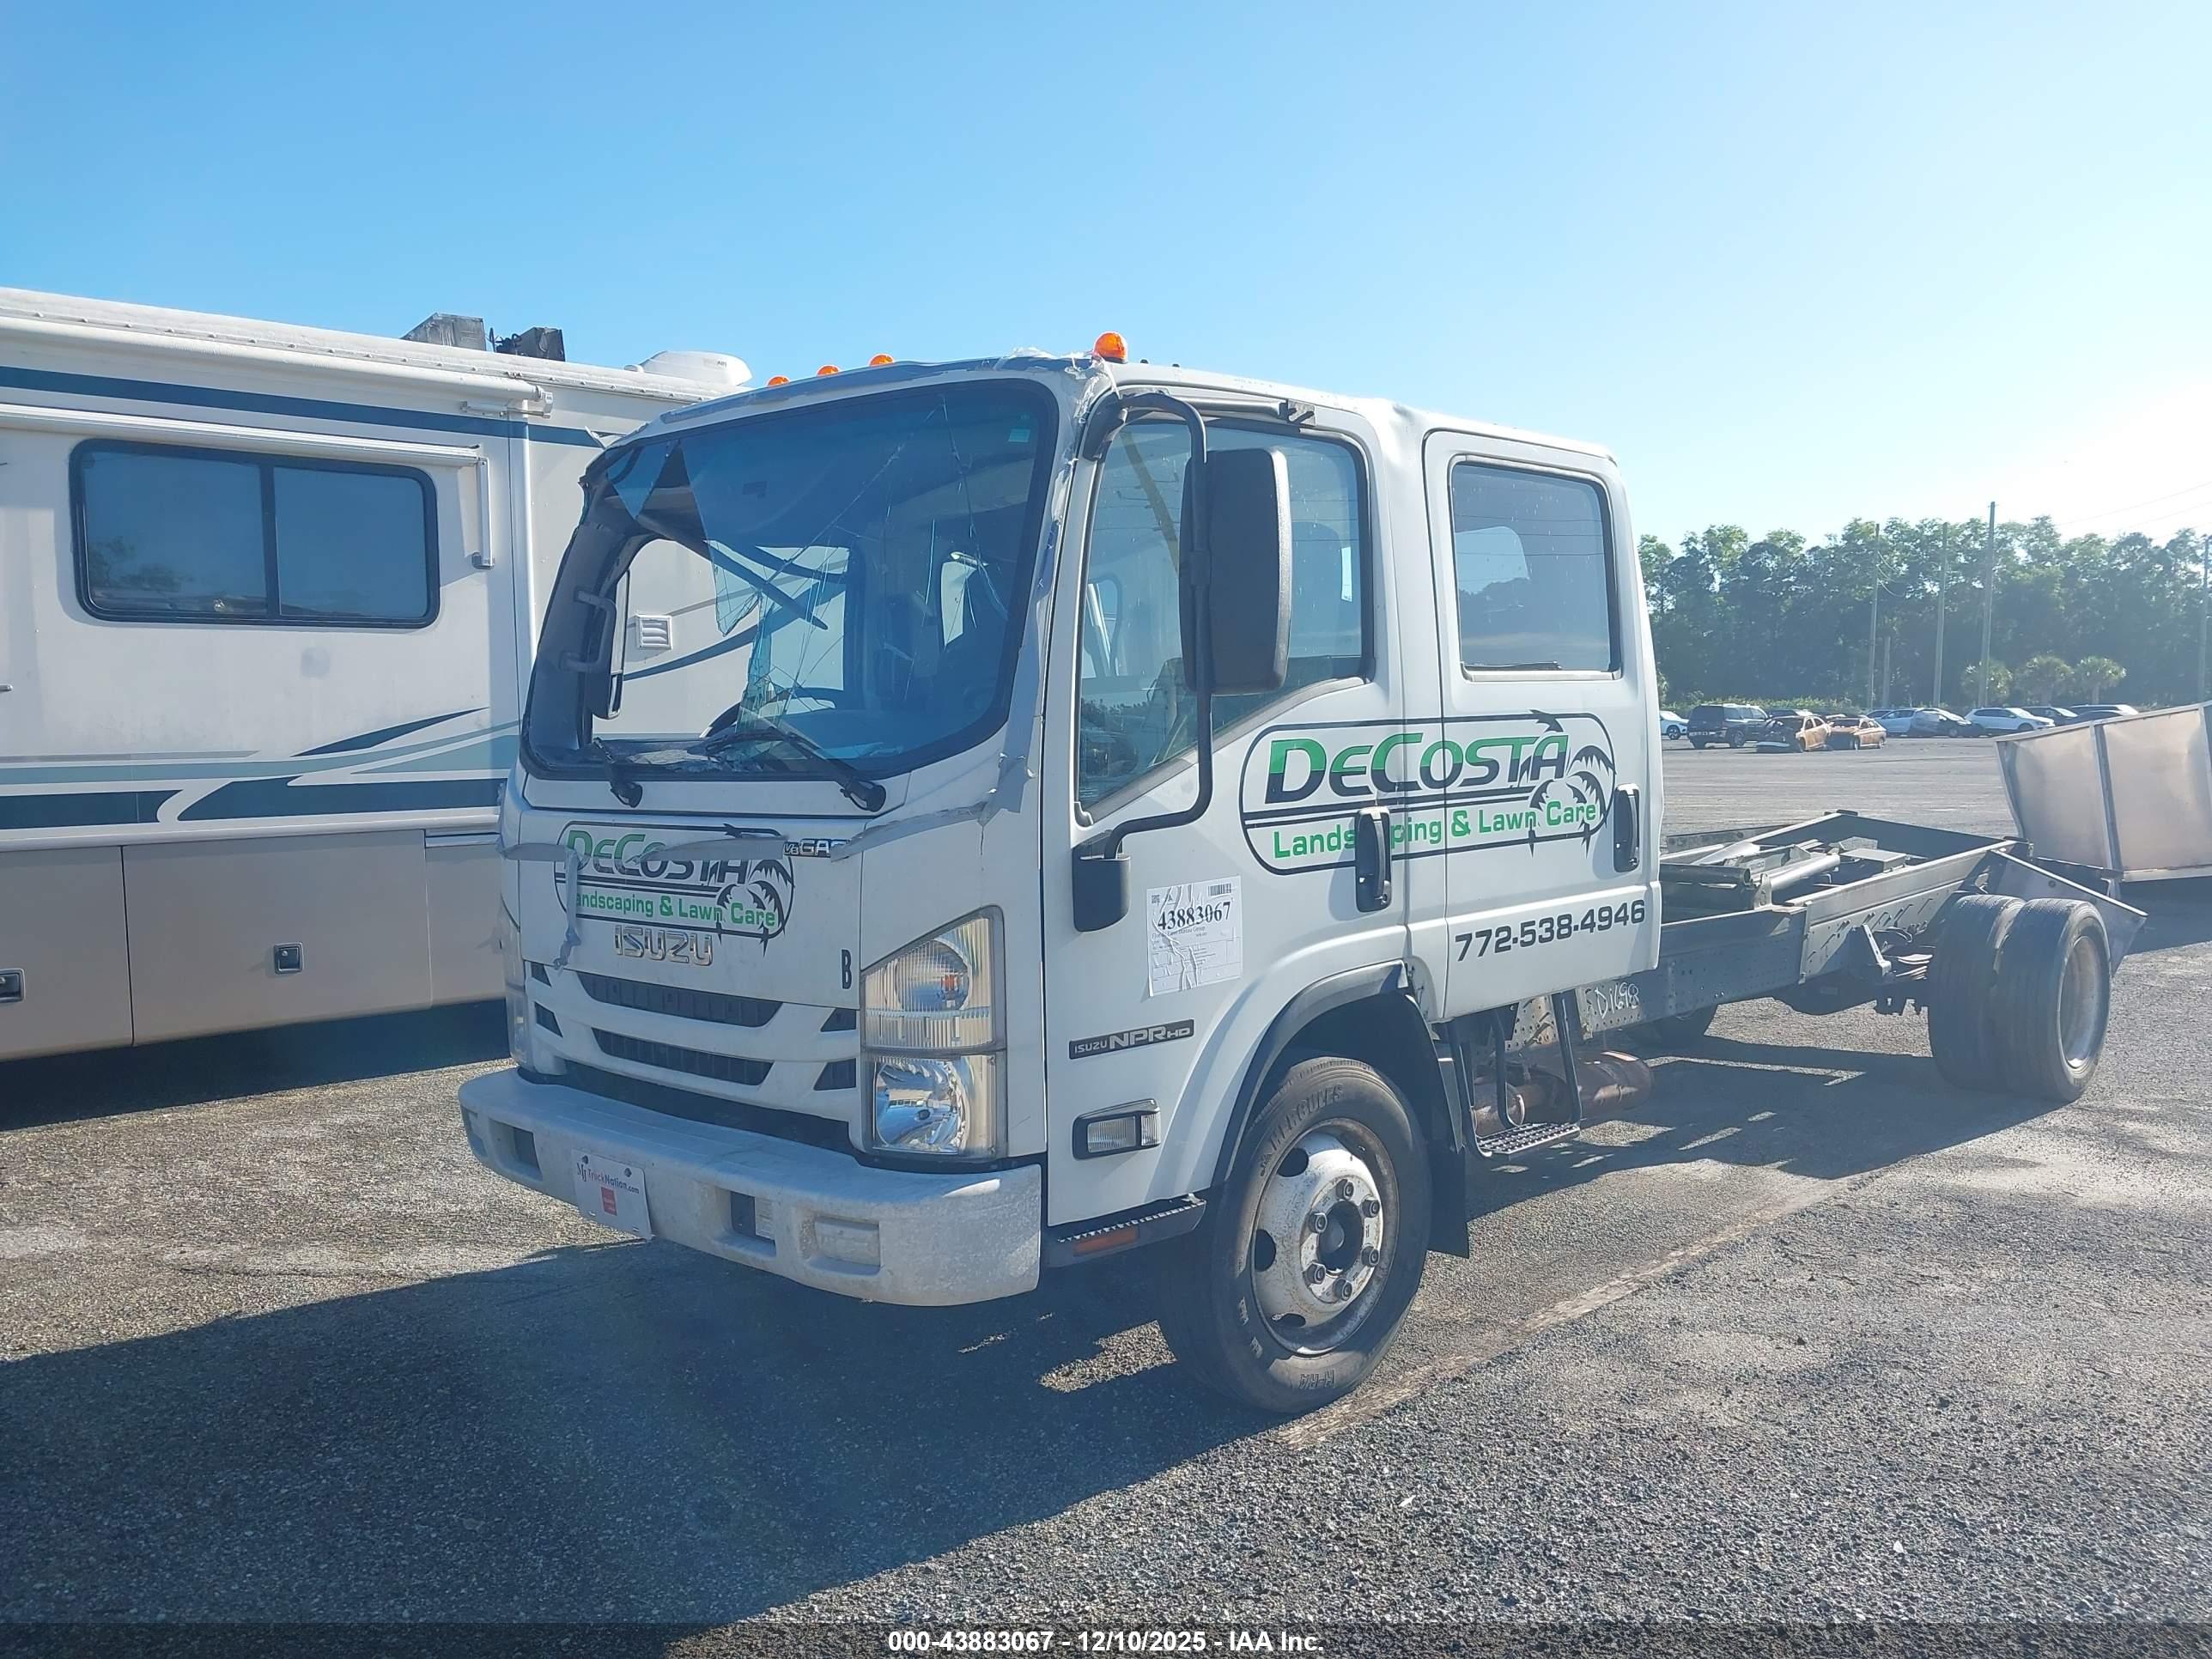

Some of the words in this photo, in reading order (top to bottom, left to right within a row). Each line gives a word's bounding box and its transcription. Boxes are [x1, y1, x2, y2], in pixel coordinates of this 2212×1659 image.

[1273, 817, 1443, 859] Landsping
[1450, 810, 1471, 837] &
[1479, 809, 1537, 833] Lawn
[1546, 800, 1596, 826] Care
[800, 839, 848, 858] GA
[575, 891, 653, 918] andscaping
[659, 896, 673, 917] &
[678, 898, 723, 921] Lawn
[731, 902, 775, 927] Care
[1158, 902, 1231, 930] 43883067
[614, 925, 714, 967] ISUZU
[841, 948, 852, 990] B
[1074, 1039, 1108, 1054] ISUZU
[1109, 1026, 1167, 1049] NPR
[1166, 1028, 1191, 1038] HD
